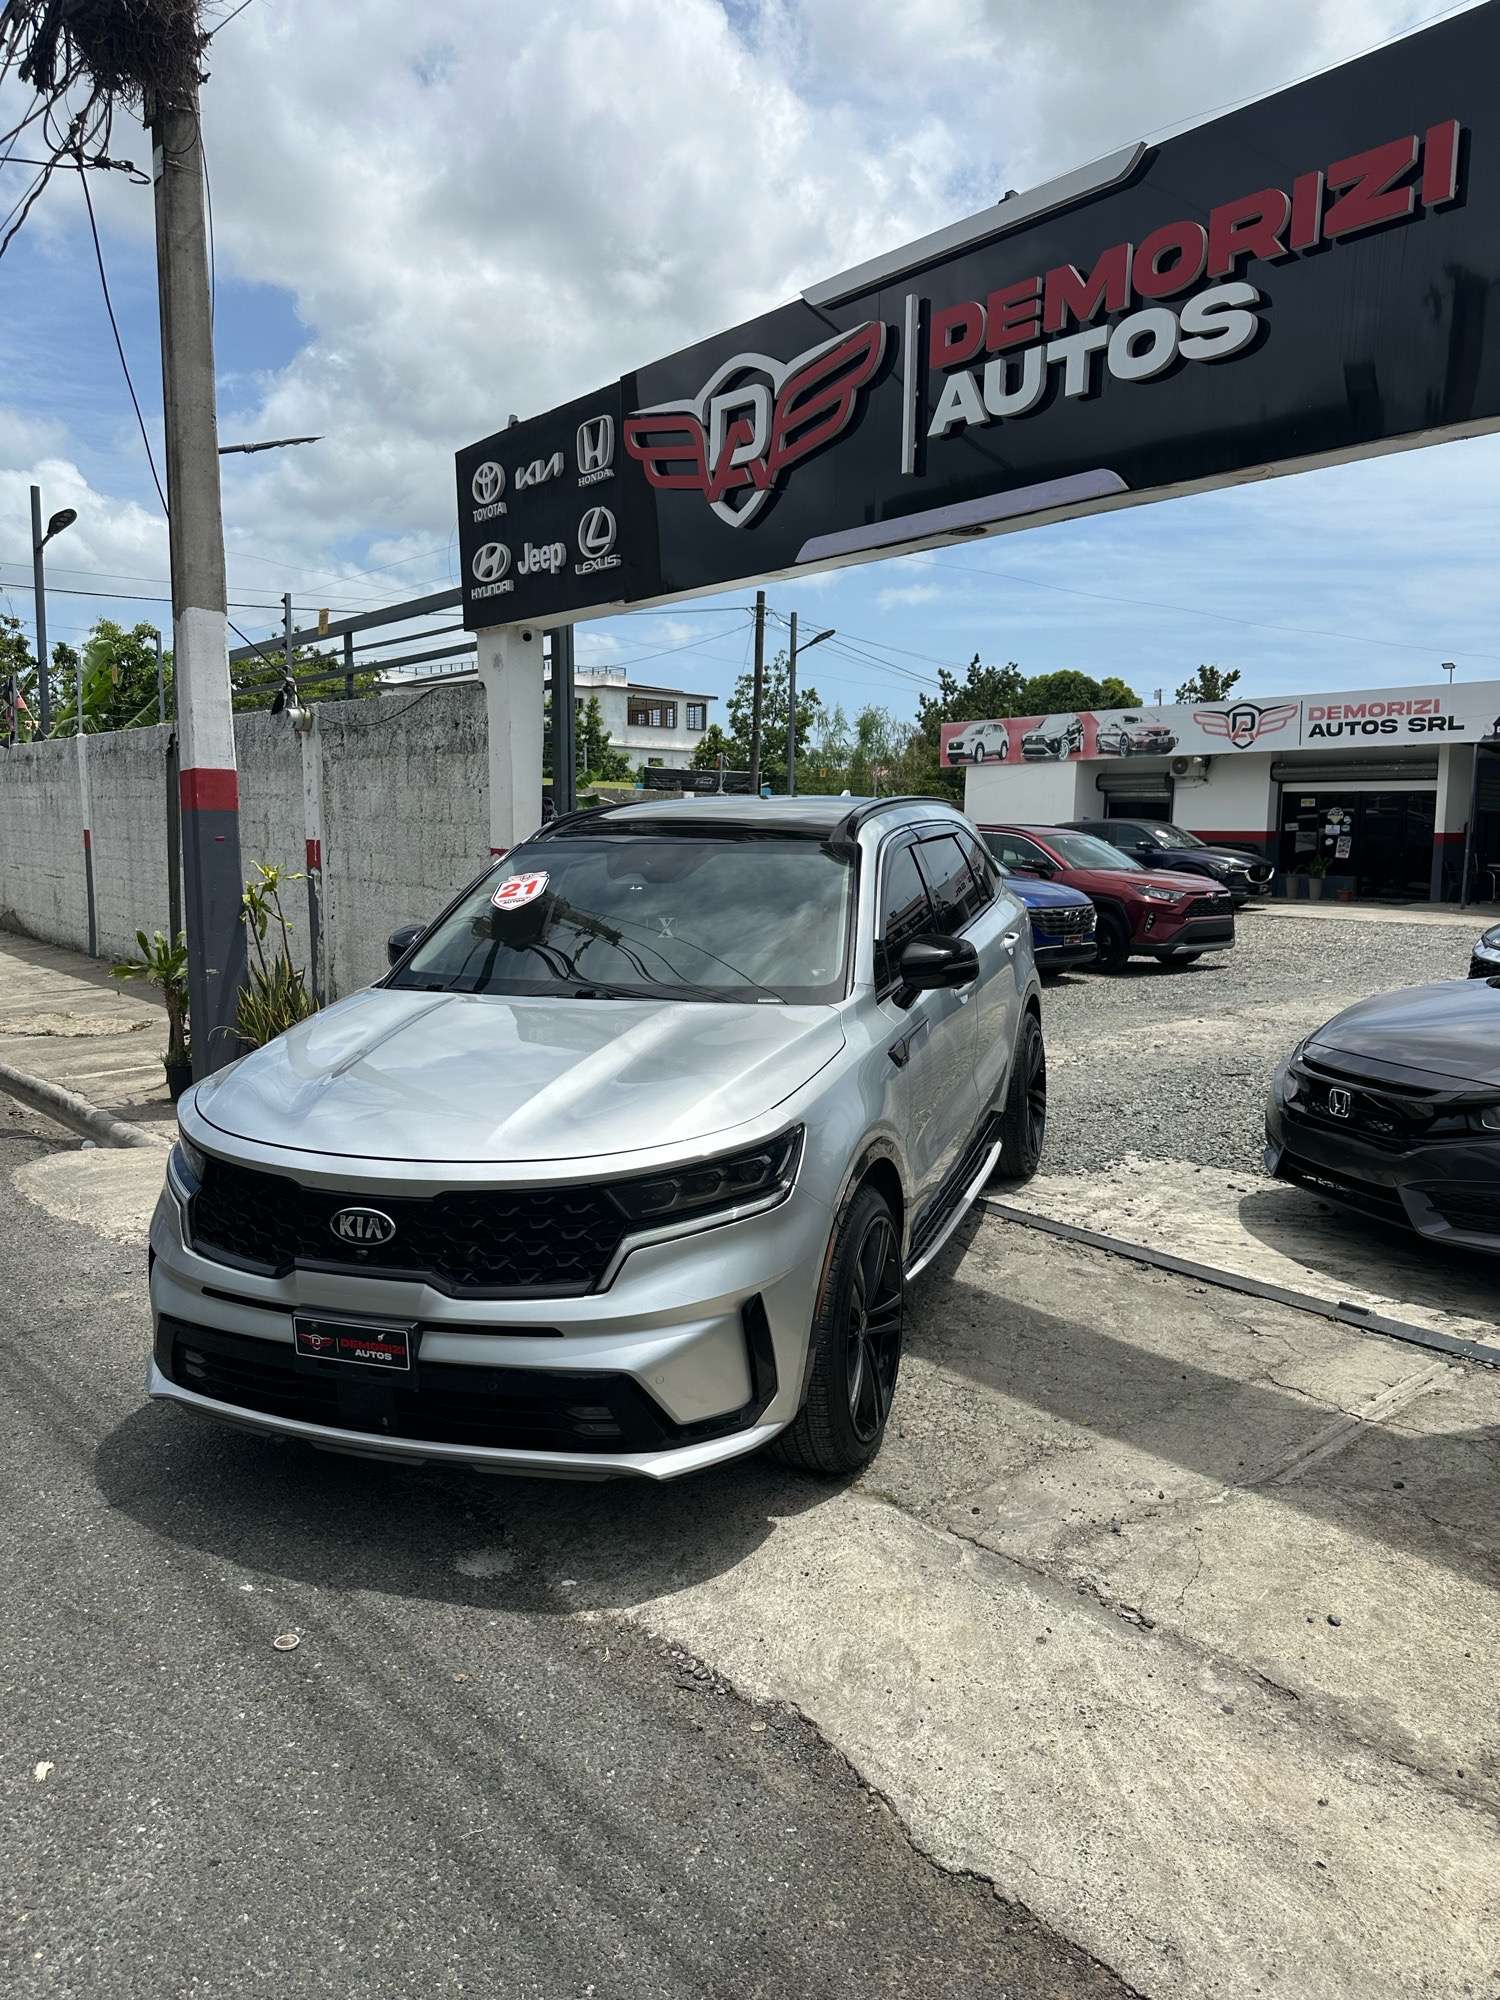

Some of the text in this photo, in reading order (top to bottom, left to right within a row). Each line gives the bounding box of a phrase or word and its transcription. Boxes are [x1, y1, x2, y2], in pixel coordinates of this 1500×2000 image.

[929, 119, 1461, 369] DEMORIZI
[926, 281, 1261, 439] AUTOS
[514, 451, 565, 490] KIA
[577, 468, 615, 487] HONDA
[472, 502, 507, 523] TOYOTA
[517, 541, 567, 575] Jeep
[574, 554, 622, 575] LEXUS
[471, 579, 515, 600] HYUNDAI
[1308, 698, 1441, 721] DEMORIZI
[1308, 715, 1465, 738] AUTOS SRL
[497, 880, 538, 898] 21
[339, 1214, 384, 1239] KIA
[340, 1337, 406, 1356] DEMORIZI
[354, 1349, 393, 1361] AUTOS
